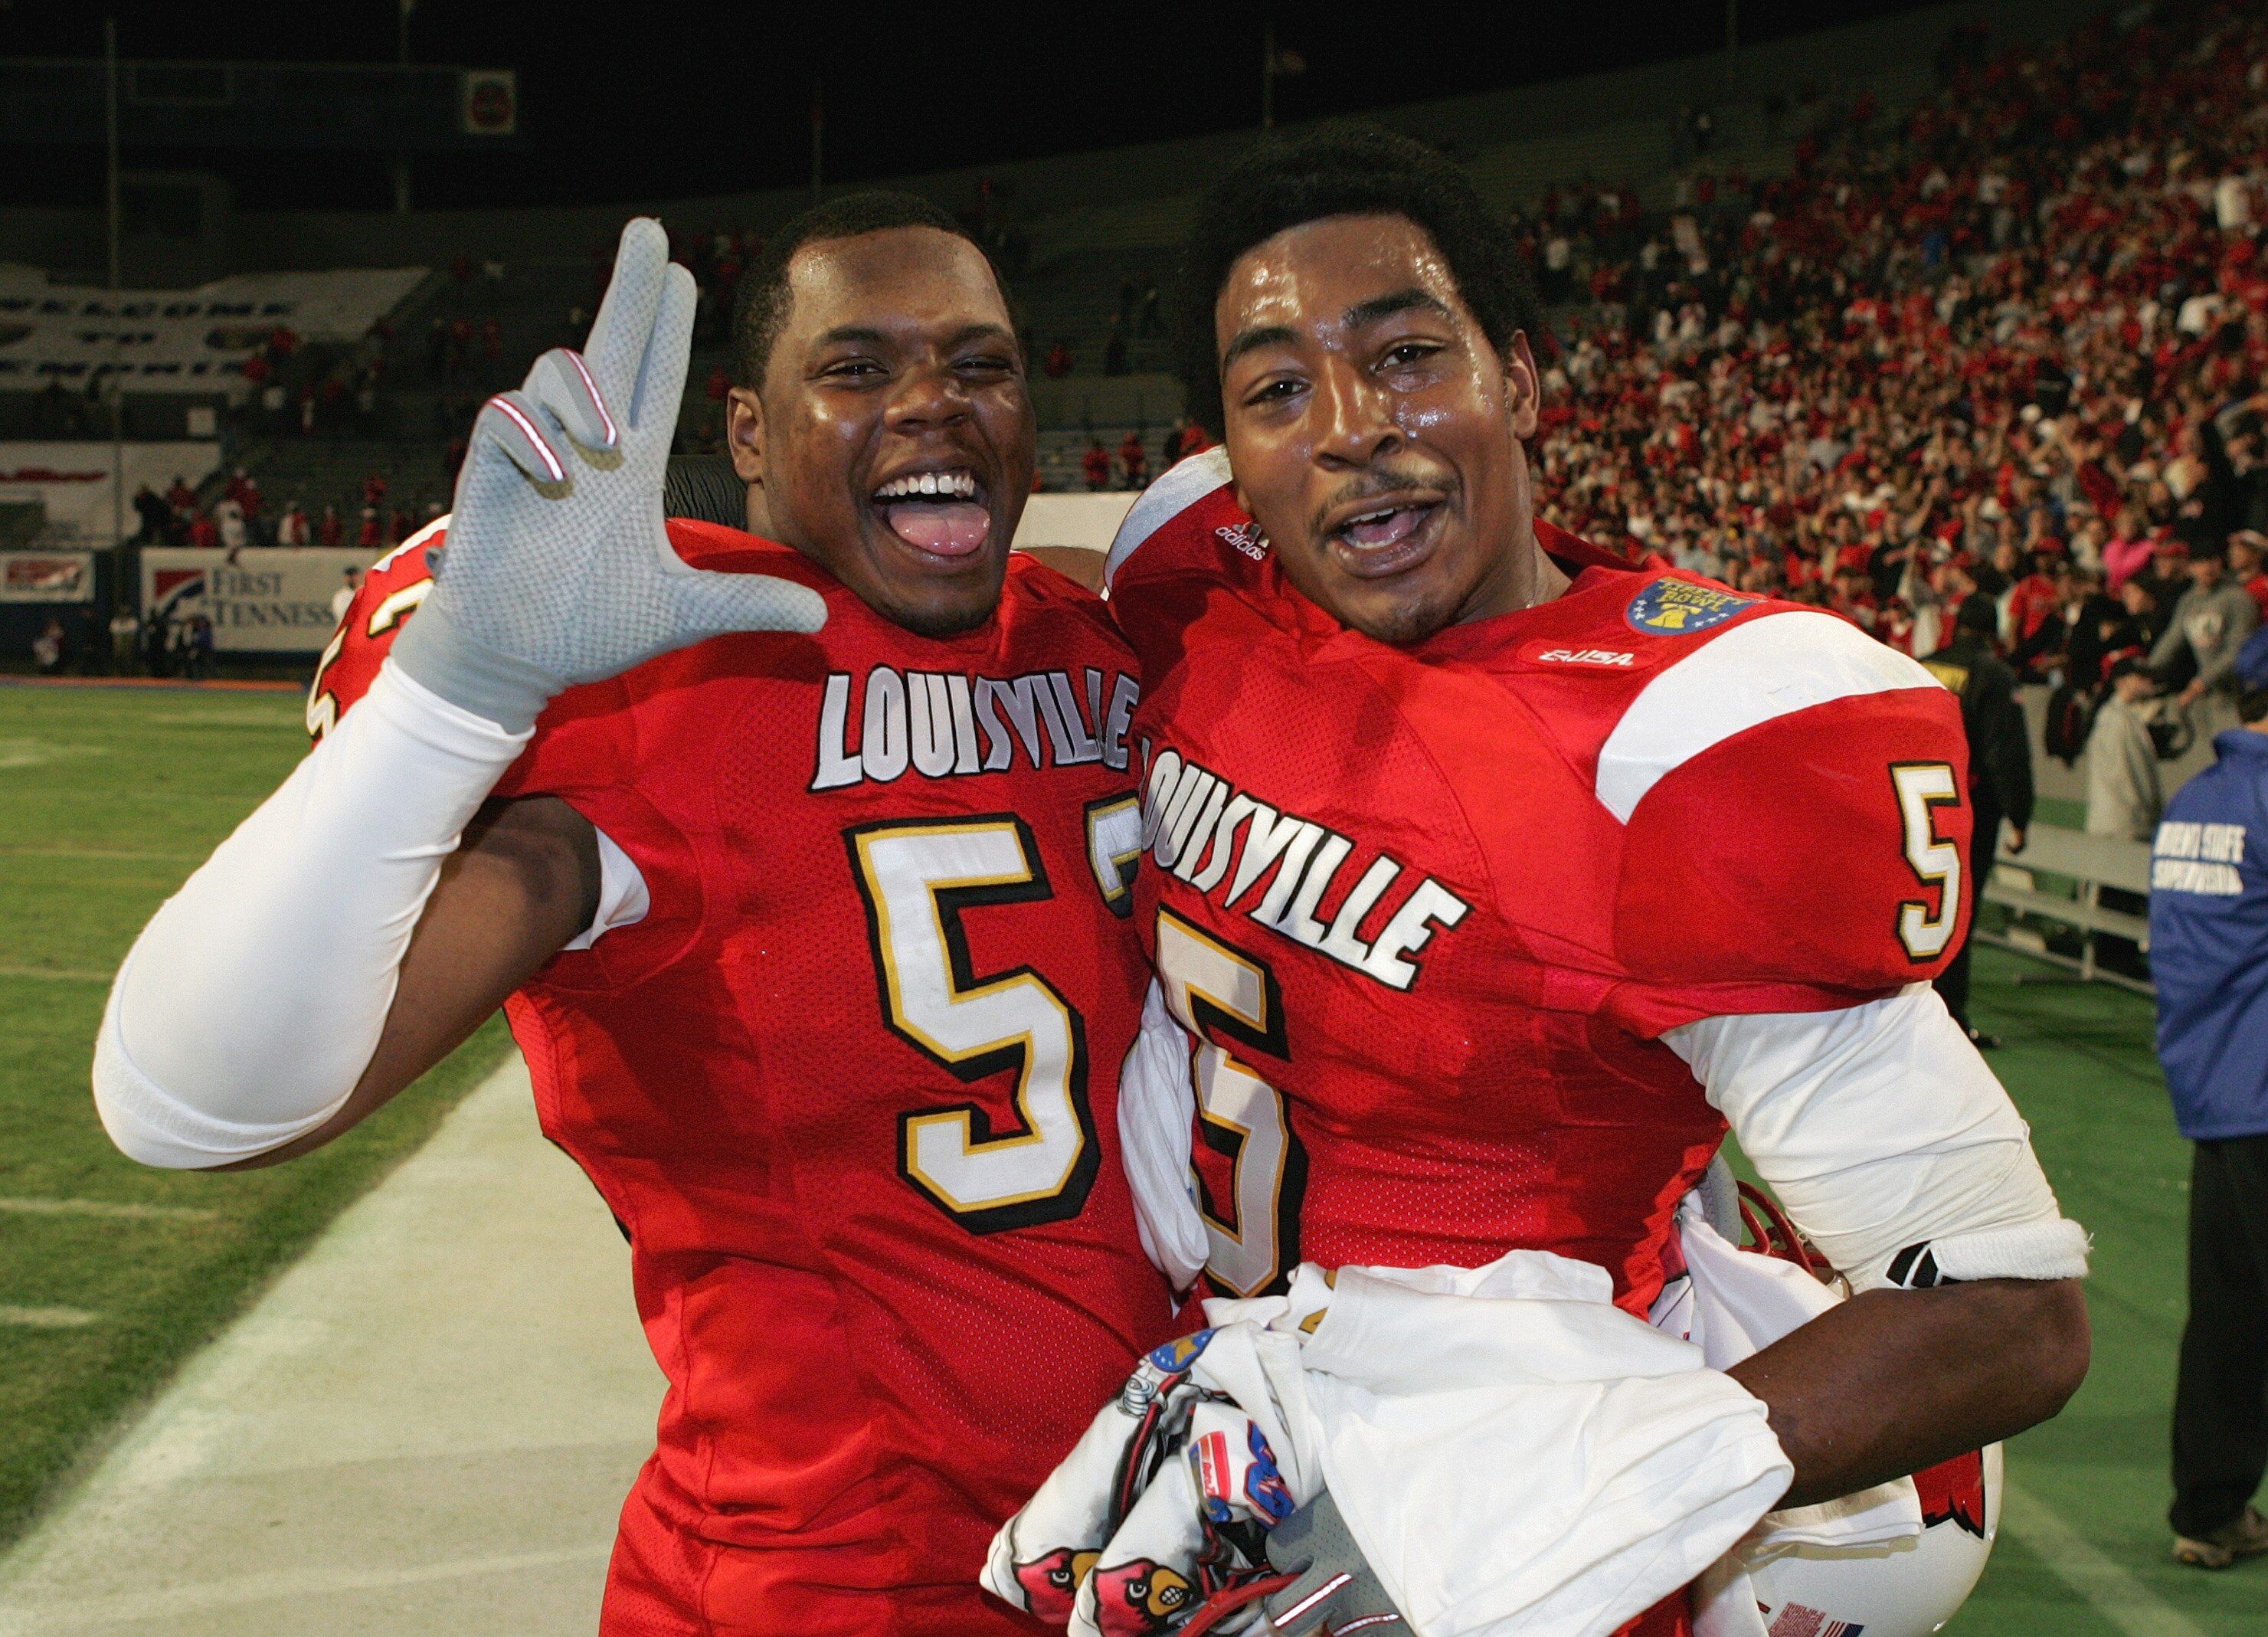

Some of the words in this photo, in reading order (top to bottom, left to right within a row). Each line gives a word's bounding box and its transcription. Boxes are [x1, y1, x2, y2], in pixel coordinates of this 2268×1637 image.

[211, 568, 284, 596] FIRST
[1215, 524, 1267, 561] adidas
[1654, 590, 1730, 612] BOWL
[809, 665, 1141, 791] LOUISVILLE
[1888, 761, 1962, 964] 5
[1154, 904, 1310, 1298] 5
